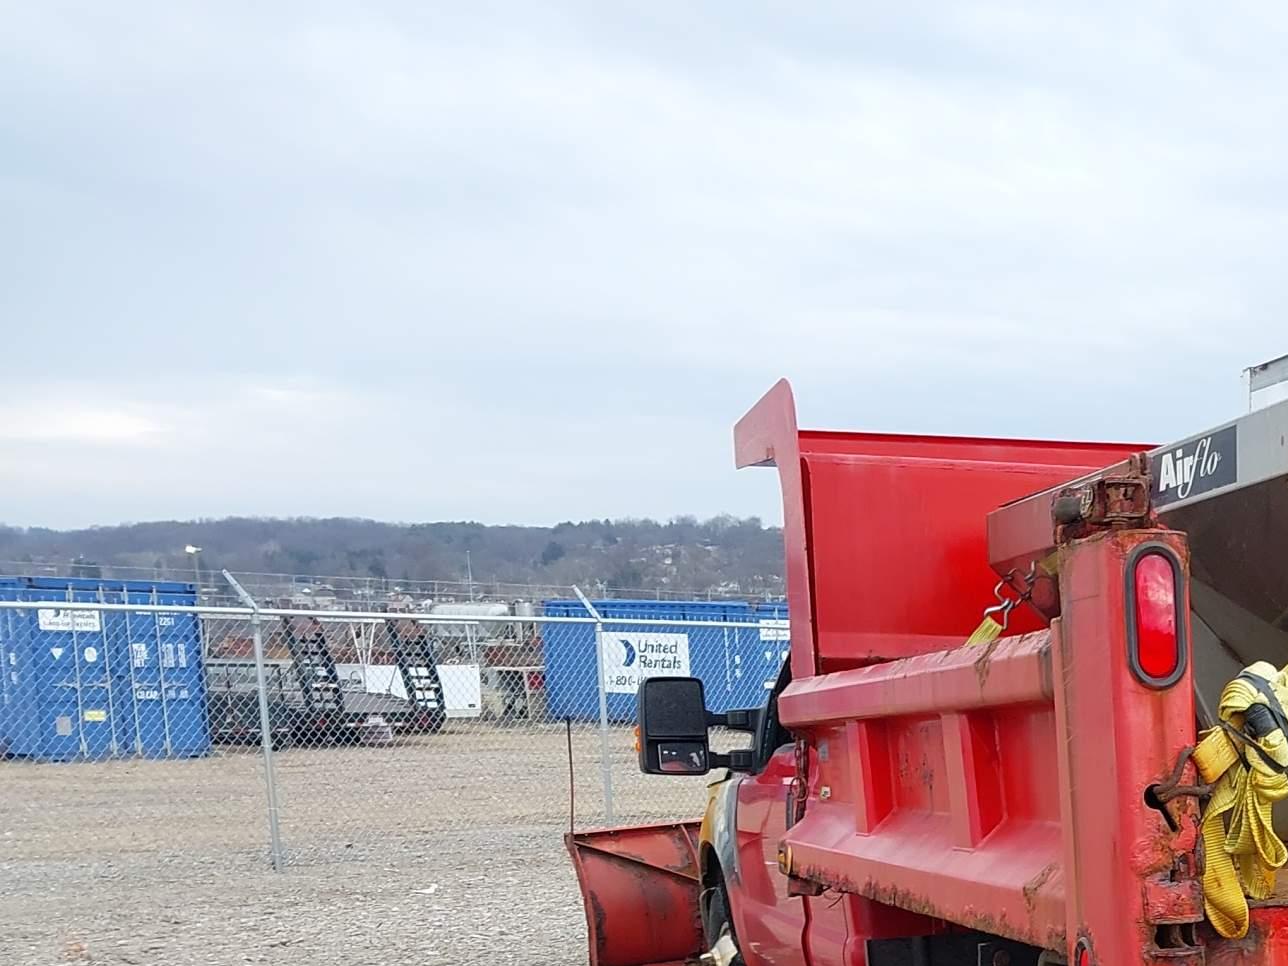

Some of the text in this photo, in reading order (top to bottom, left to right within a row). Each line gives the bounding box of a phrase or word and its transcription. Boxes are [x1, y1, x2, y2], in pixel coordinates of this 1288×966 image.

[1159, 437, 1221, 498] Airflo
[638, 639, 678, 654] United
[638, 655, 682, 669] Rentals
